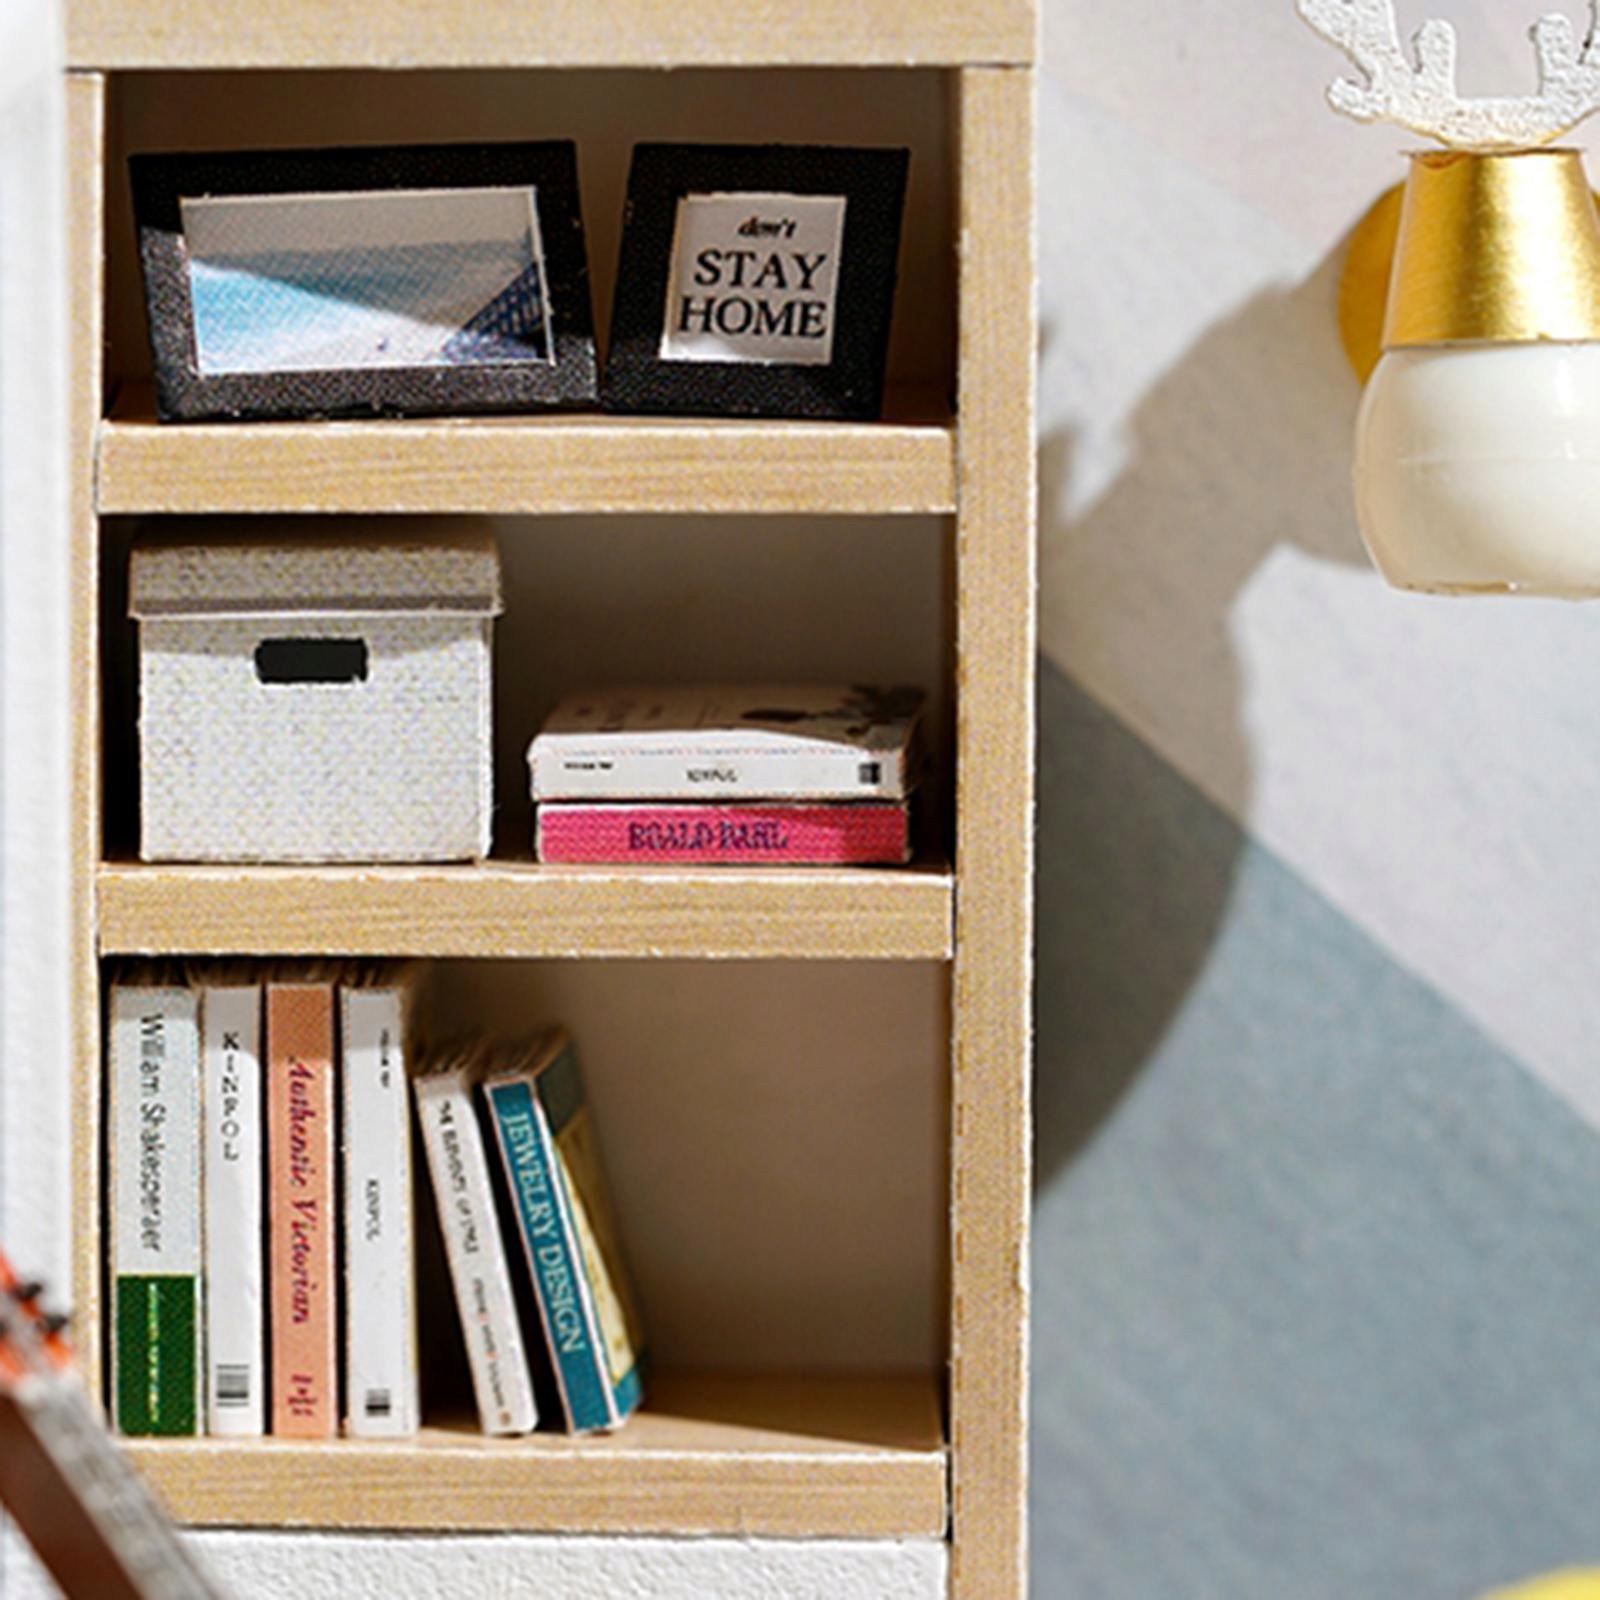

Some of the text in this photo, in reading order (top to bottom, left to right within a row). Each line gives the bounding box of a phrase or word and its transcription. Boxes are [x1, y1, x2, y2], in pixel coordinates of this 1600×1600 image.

[738, 215, 797, 238] don't
[694, 248, 827, 290] STAY
[678, 296, 827, 339] HOME
[288, 1056, 318, 1324] Authentic Victorian
[502, 1112, 586, 1353] JEWELRY DESIGN
